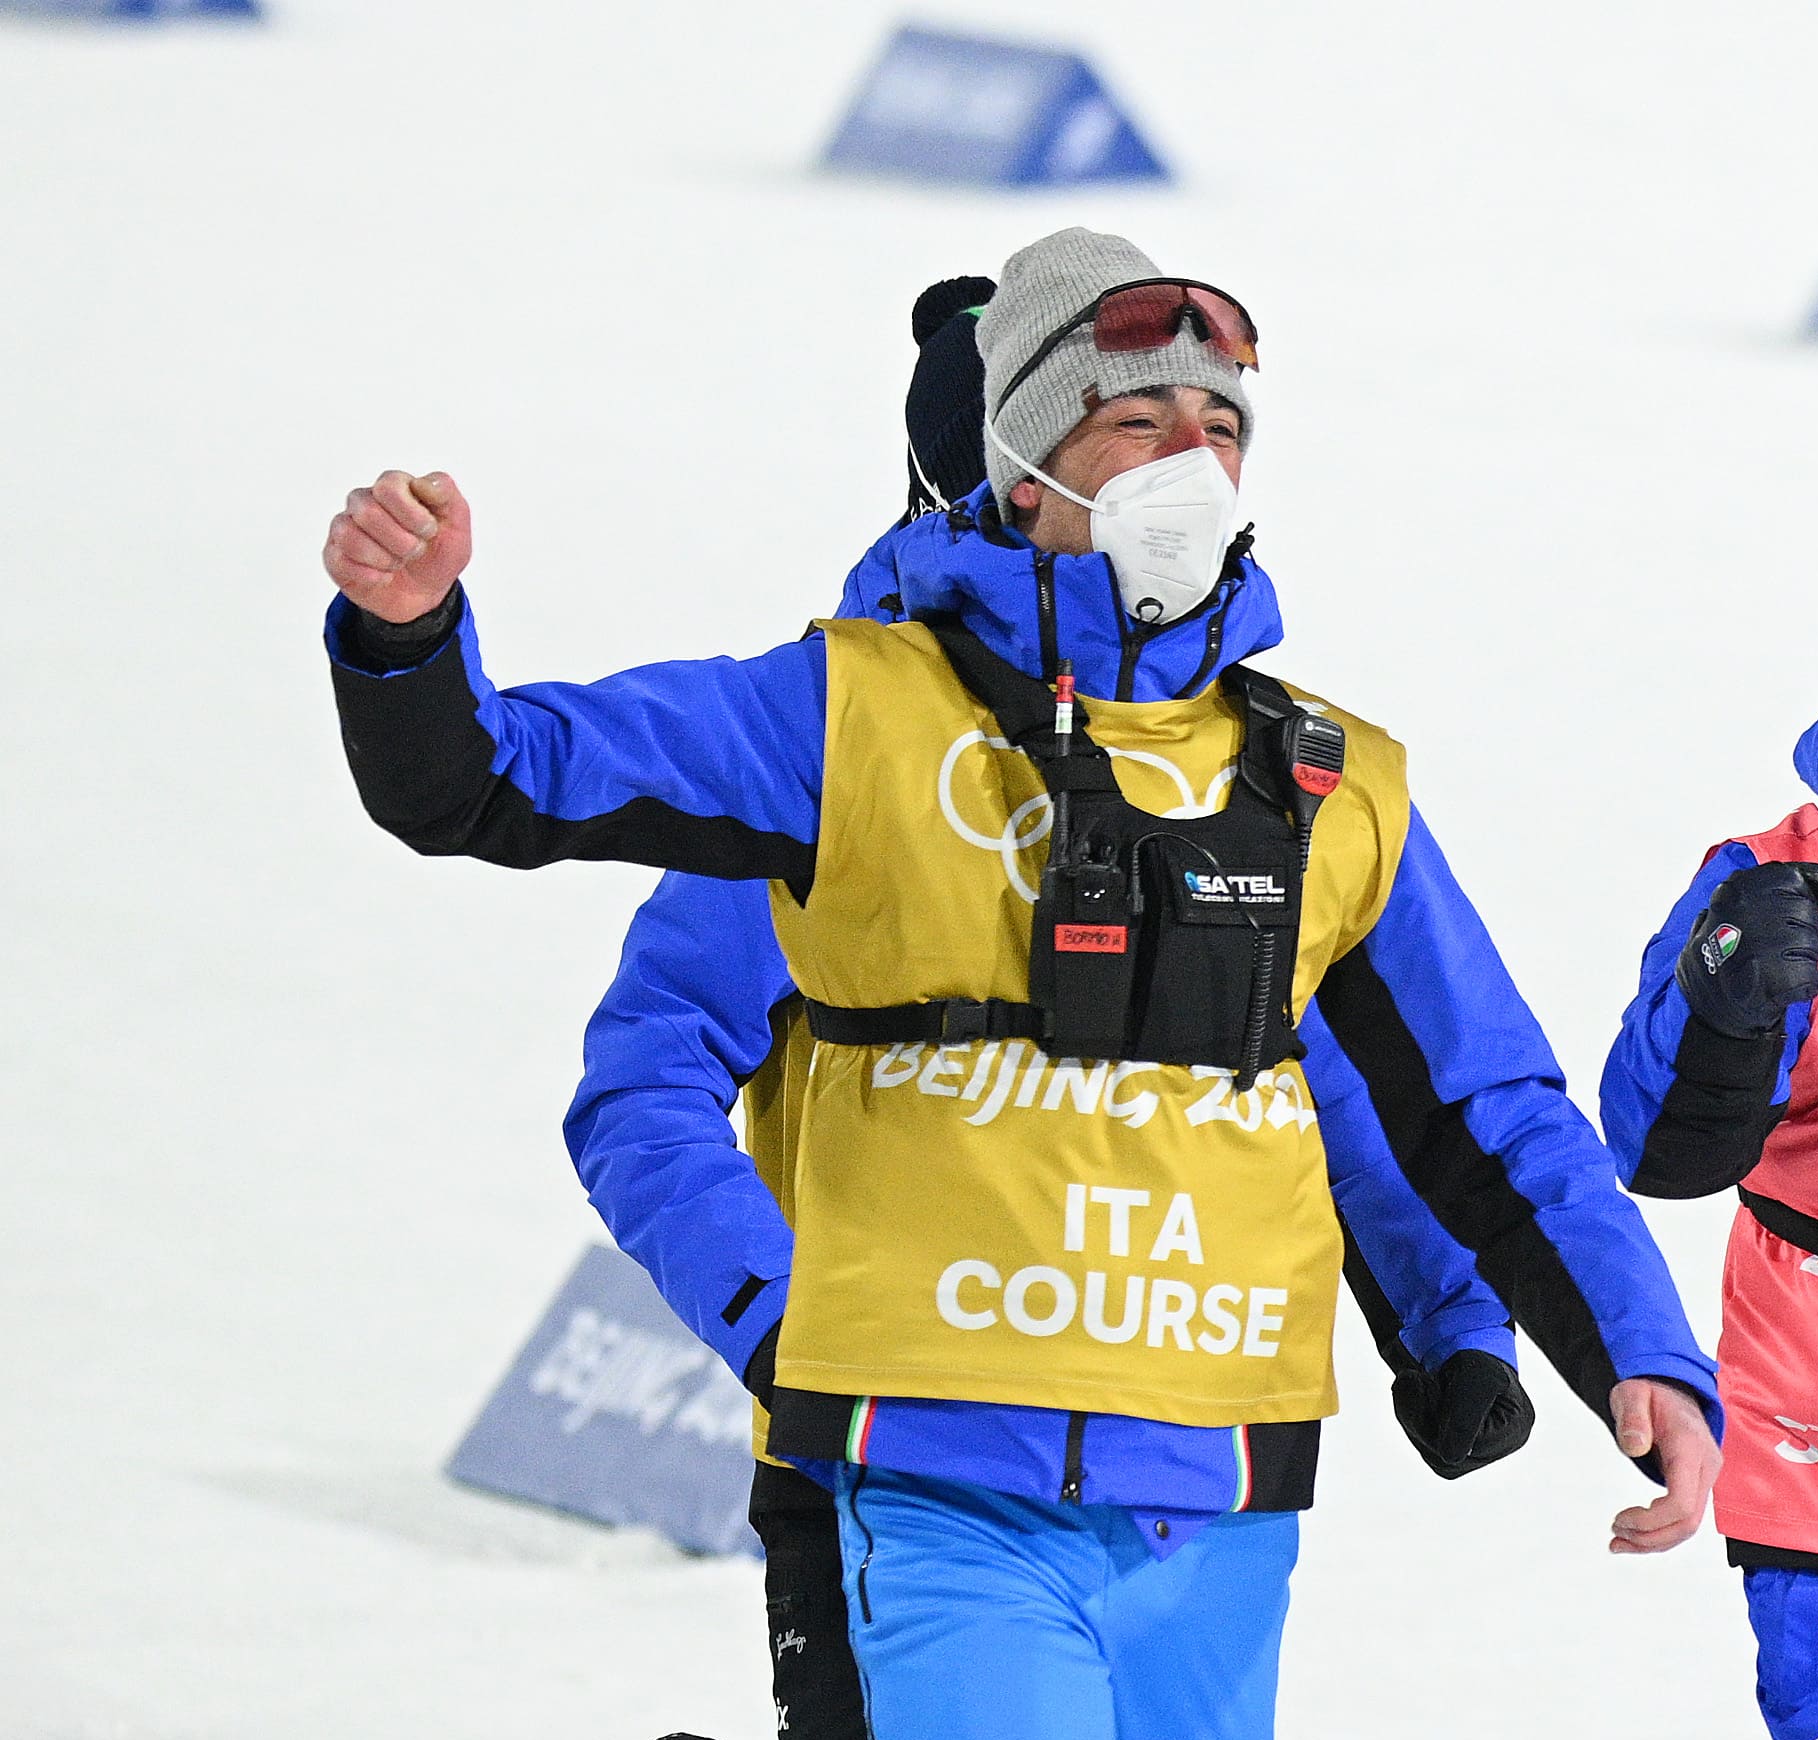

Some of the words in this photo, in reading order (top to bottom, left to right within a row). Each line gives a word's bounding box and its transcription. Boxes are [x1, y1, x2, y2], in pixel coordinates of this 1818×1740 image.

[872, 1041, 1160, 1128] BEIJING
[1063, 1183, 1204, 1265] ITA
[935, 1259, 1288, 1358] COURSE
